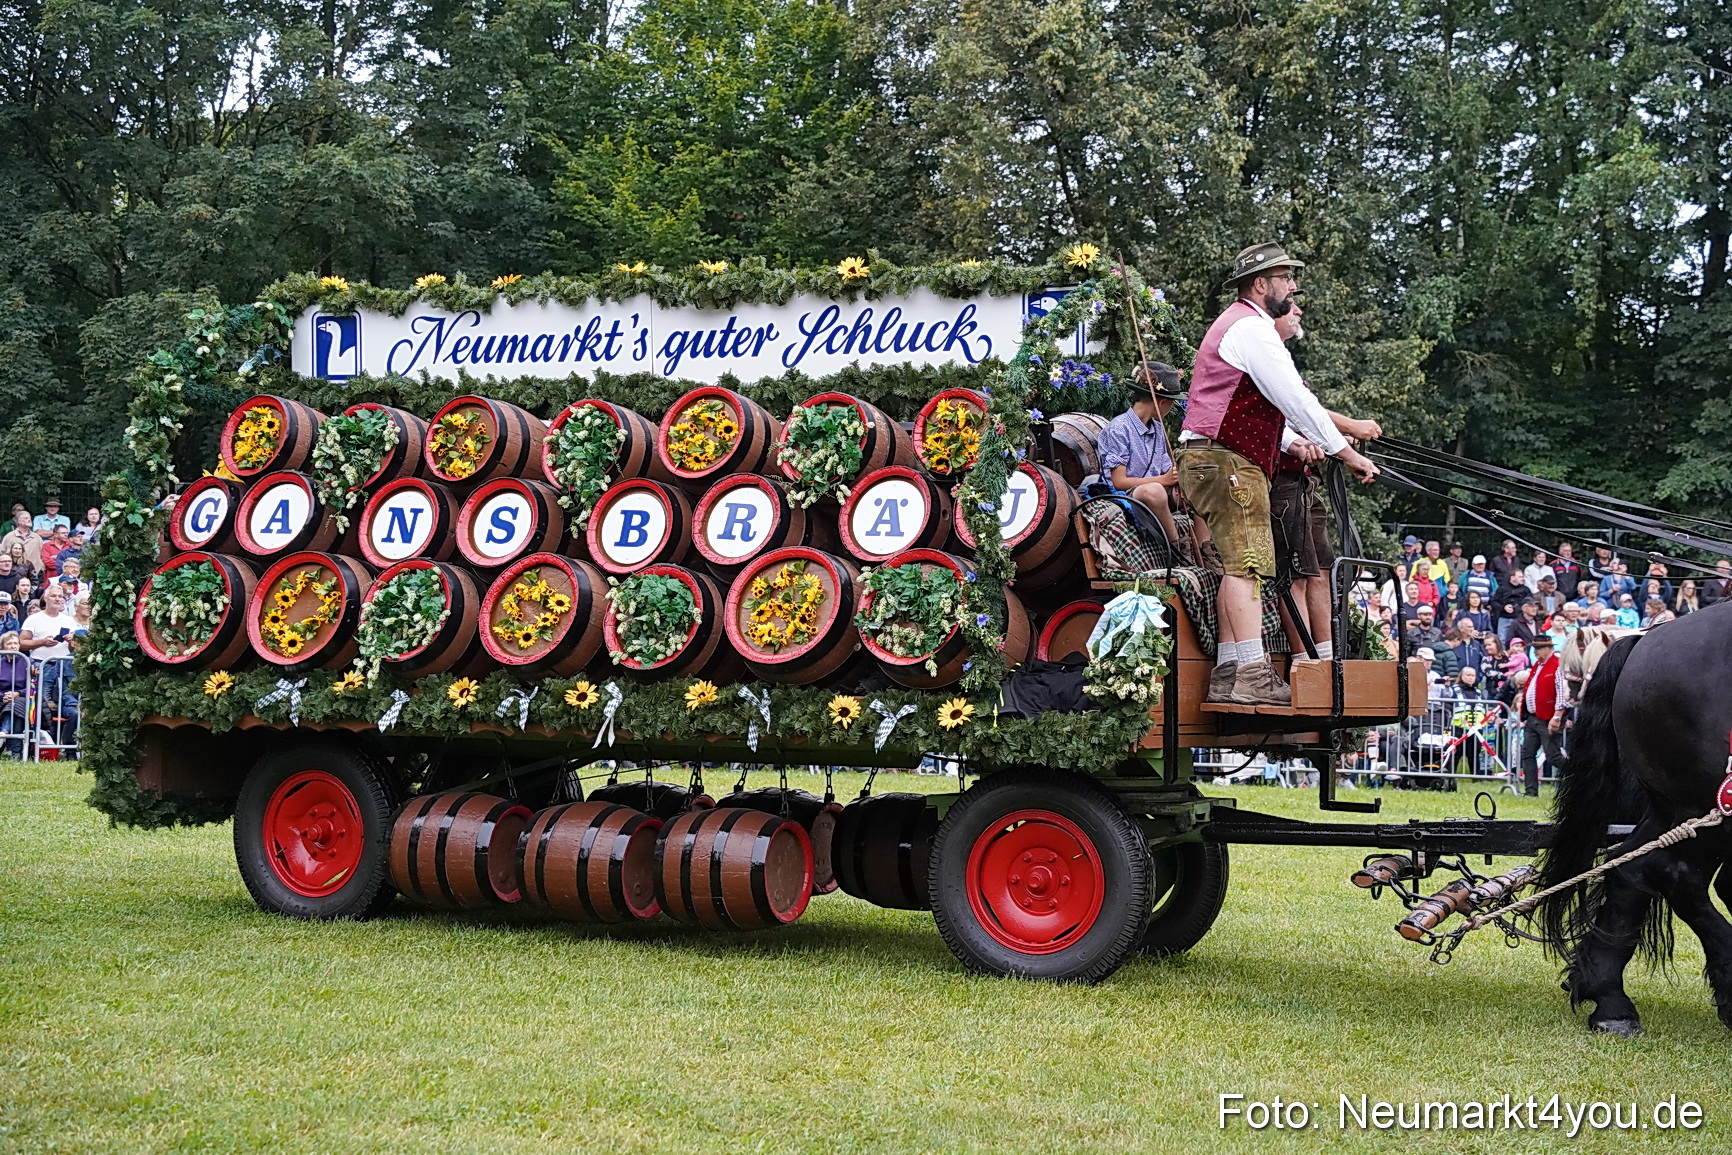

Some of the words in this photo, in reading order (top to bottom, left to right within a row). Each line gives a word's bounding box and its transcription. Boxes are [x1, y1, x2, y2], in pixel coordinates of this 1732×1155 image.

[386, 310, 649, 377] Neumarkt's
[655, 316, 780, 377] guter
[781, 303, 993, 366] Schluck
